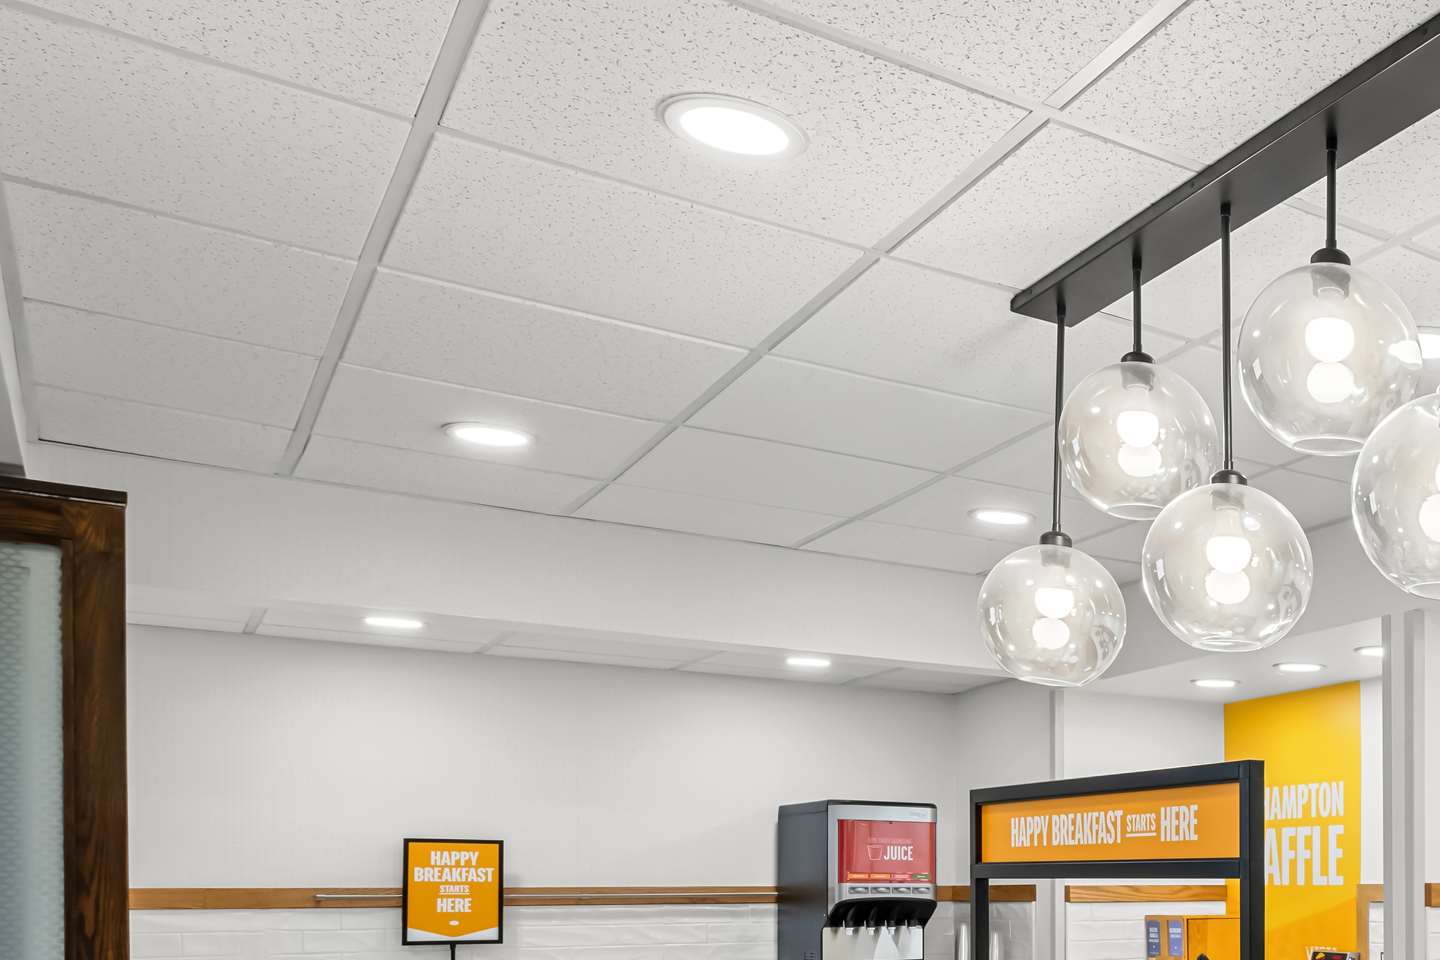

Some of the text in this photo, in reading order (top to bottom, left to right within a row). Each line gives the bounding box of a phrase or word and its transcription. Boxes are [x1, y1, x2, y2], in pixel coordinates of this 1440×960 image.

[1011, 804, 1199, 848] HAPPY BREAKFAST STARTS HERE
[430, 850, 479, 866] HAPPY
[883, 845, 914, 861] JUICE
[1264, 824, 1344, 886] AFFLE
[413, 866, 495, 882] BREAKFAST
[439, 884, 470, 893] STARTS
[436, 897, 472, 913] HERE
